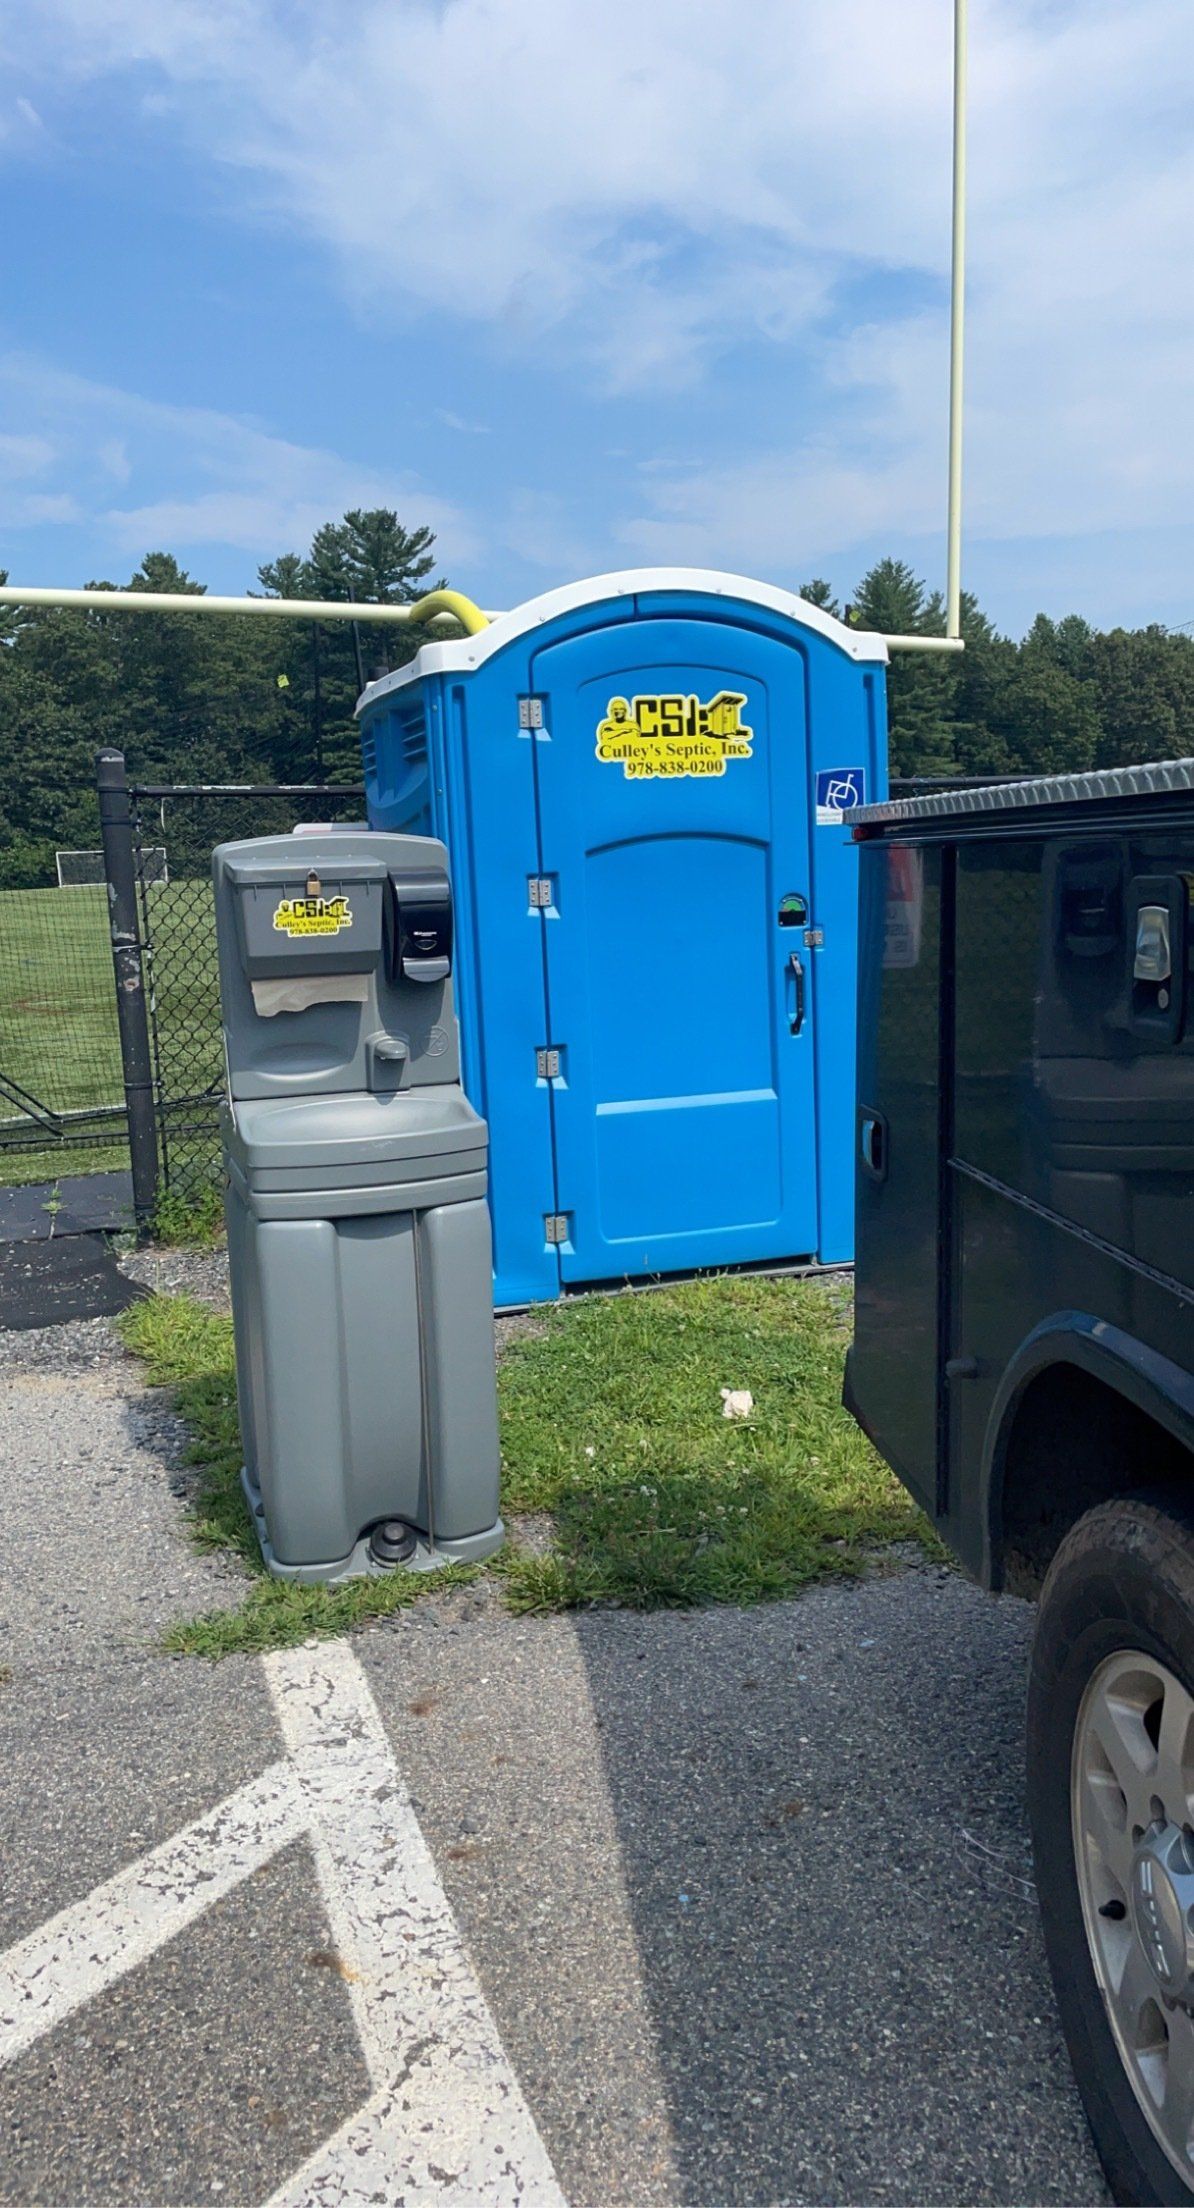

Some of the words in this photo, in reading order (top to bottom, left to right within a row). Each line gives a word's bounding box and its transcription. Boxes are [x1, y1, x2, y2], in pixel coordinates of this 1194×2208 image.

[599, 743, 661, 761] Culley's
[666, 742, 716, 759] Septic,
[721, 741, 749, 755] Inc.
[628, 760, 723, 776] 978-838-0200
